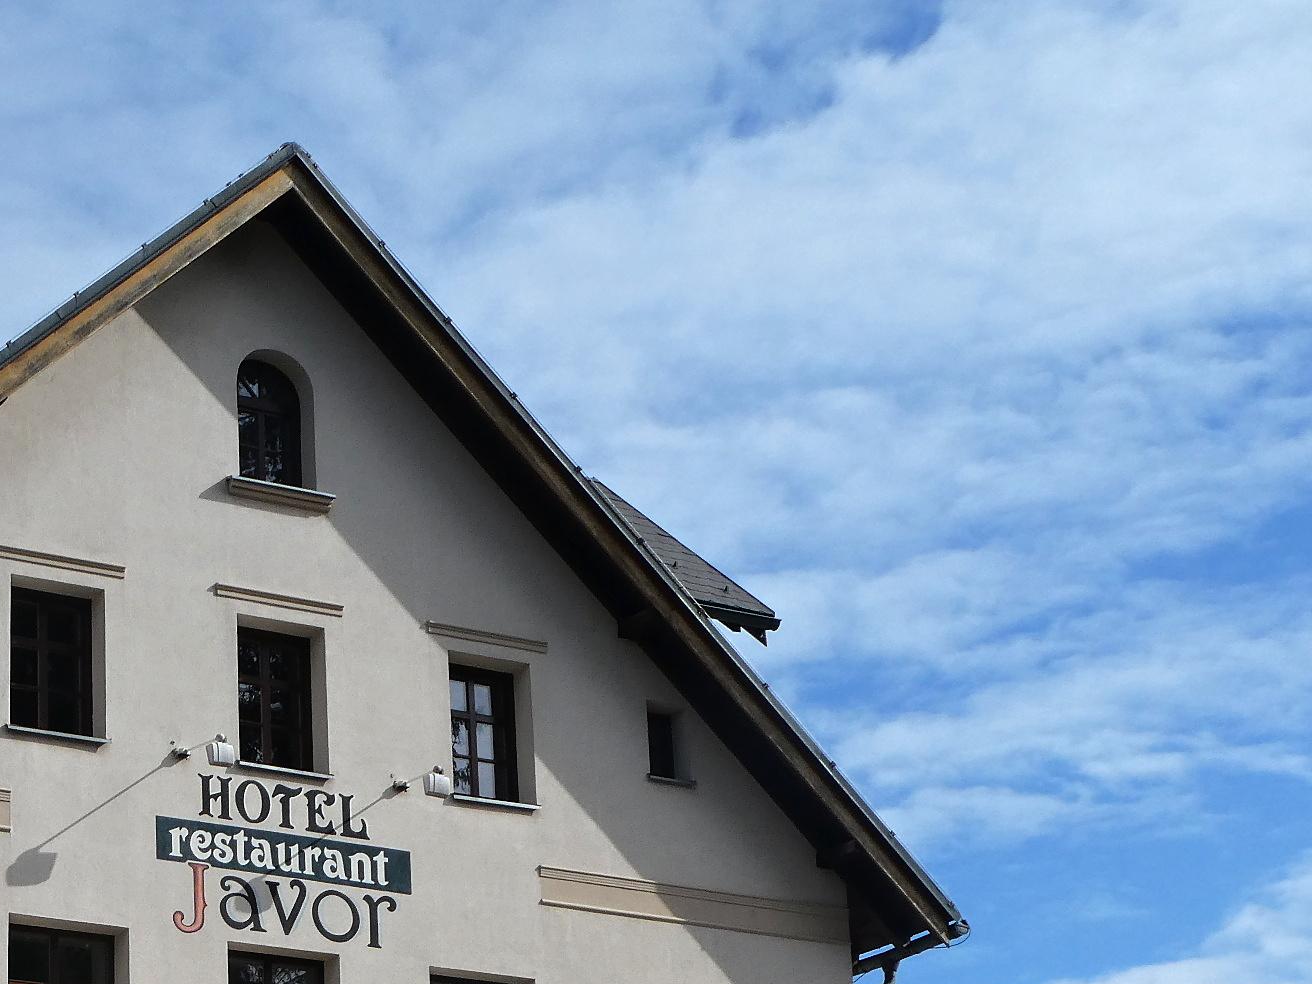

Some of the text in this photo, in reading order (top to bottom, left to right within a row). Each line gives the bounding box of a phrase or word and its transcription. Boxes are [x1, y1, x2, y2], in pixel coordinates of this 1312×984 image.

[197, 772, 371, 840] HOTEL
[168, 825, 390, 886] restaurant
[172, 862, 397, 949] Javor
